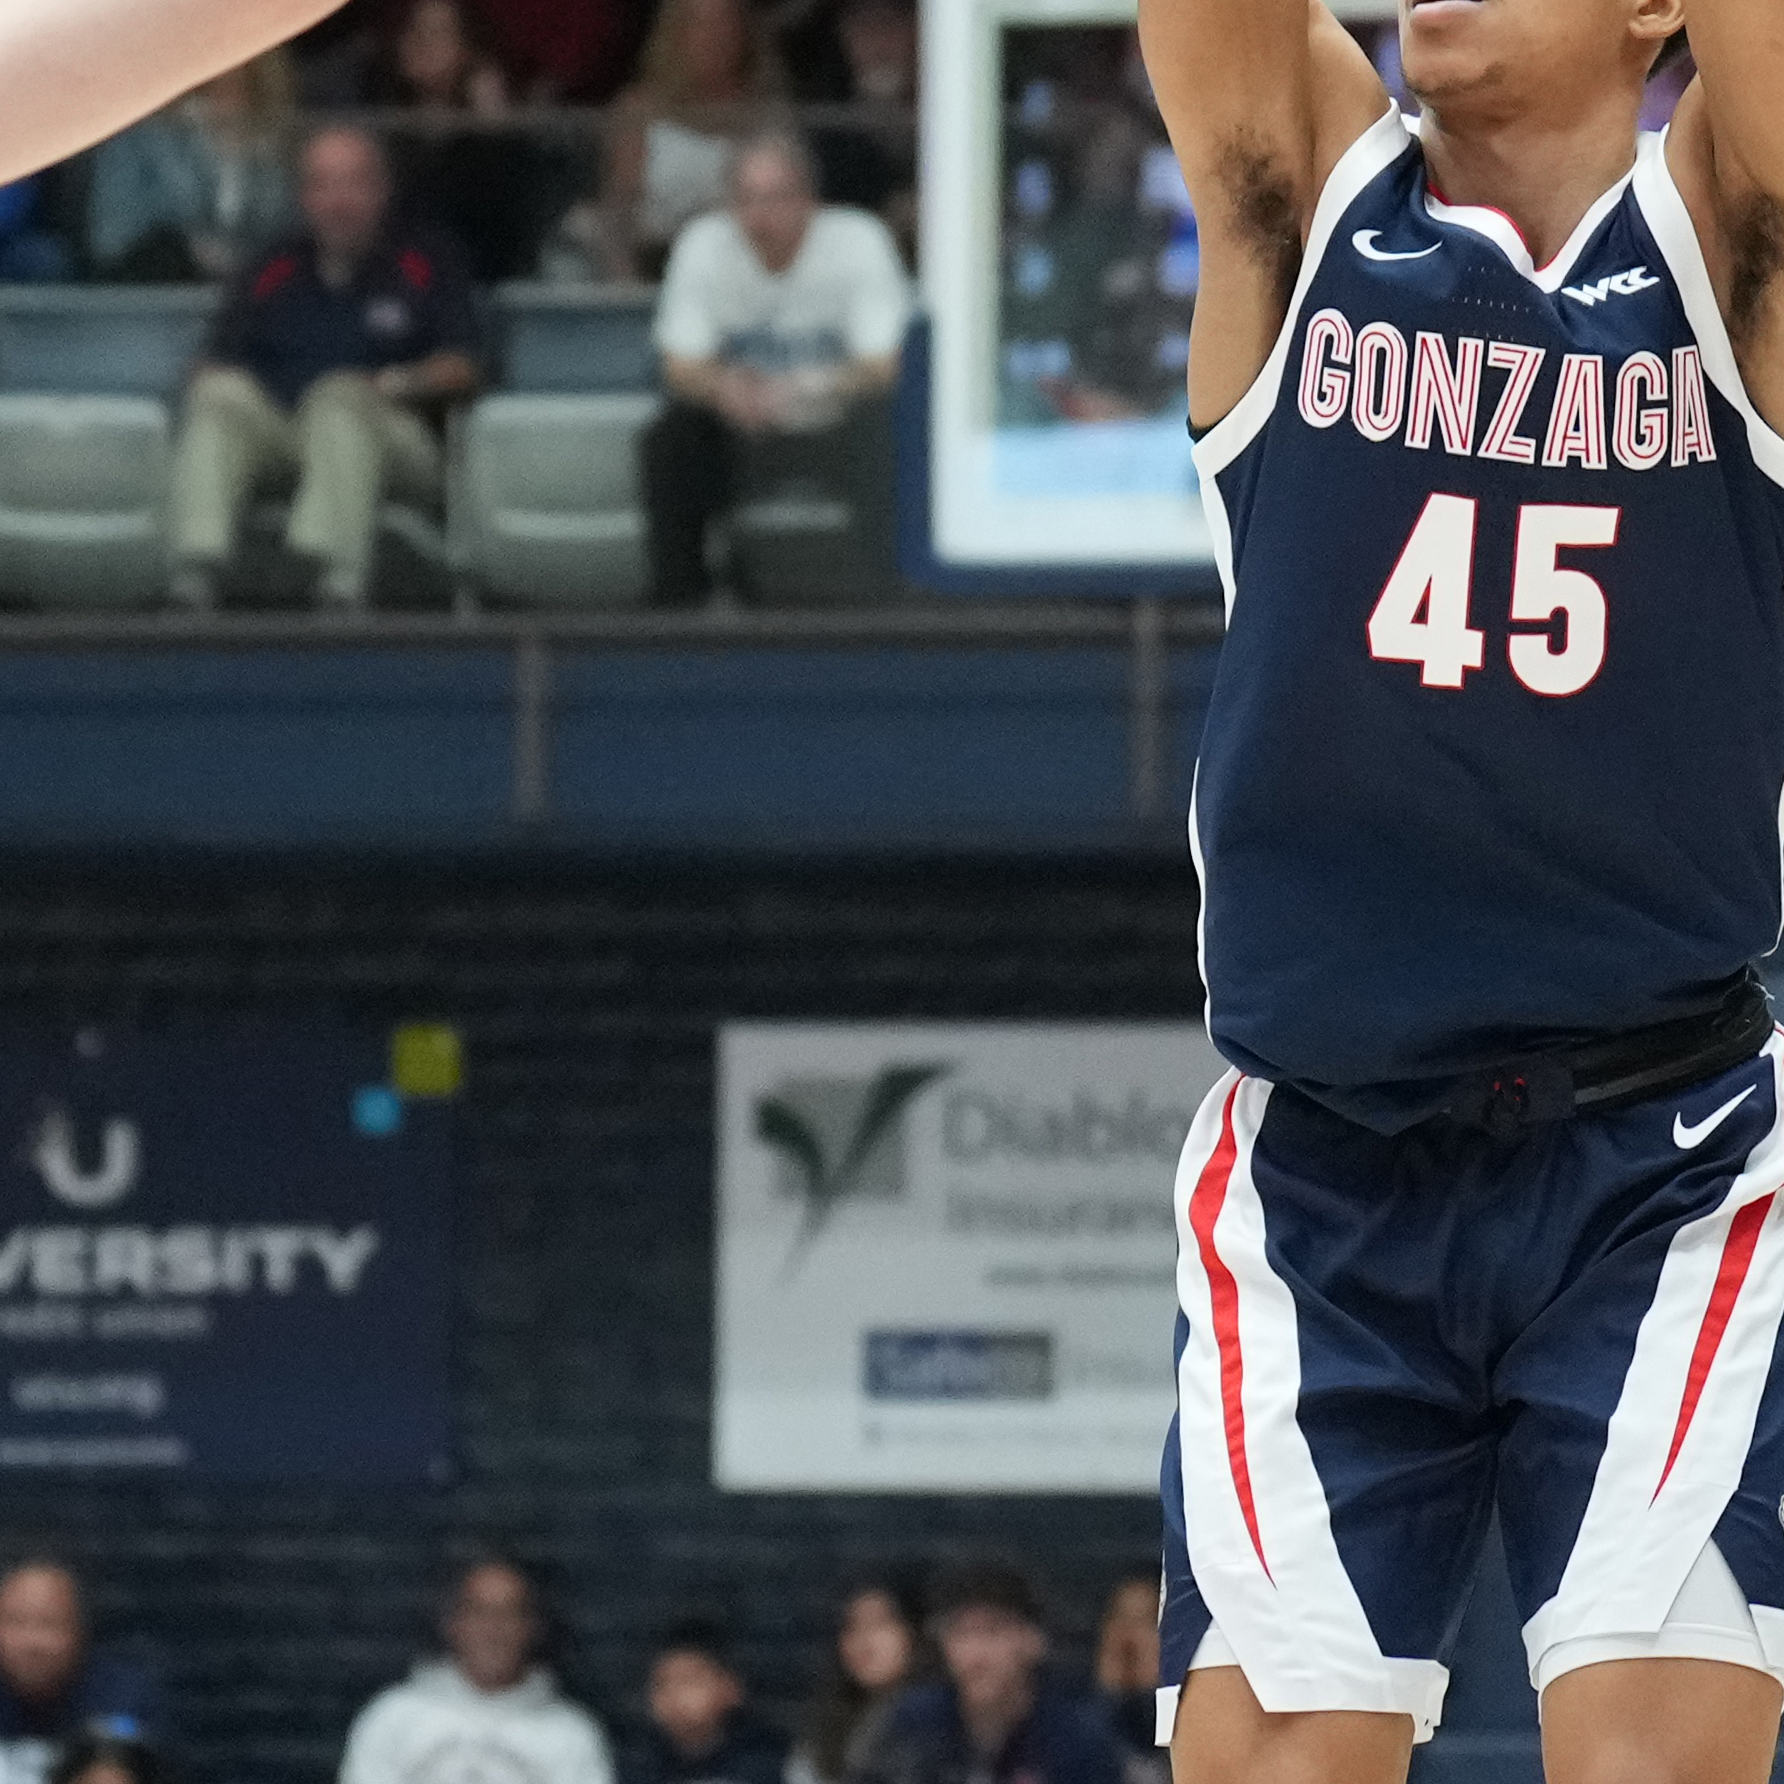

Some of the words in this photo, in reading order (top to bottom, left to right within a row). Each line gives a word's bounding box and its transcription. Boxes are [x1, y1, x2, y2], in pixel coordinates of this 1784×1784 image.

[1560, 265, 1662, 308] WCC
[1297, 306, 1718, 472] GONZAGA
[1365, 490, 1622, 698] 45
